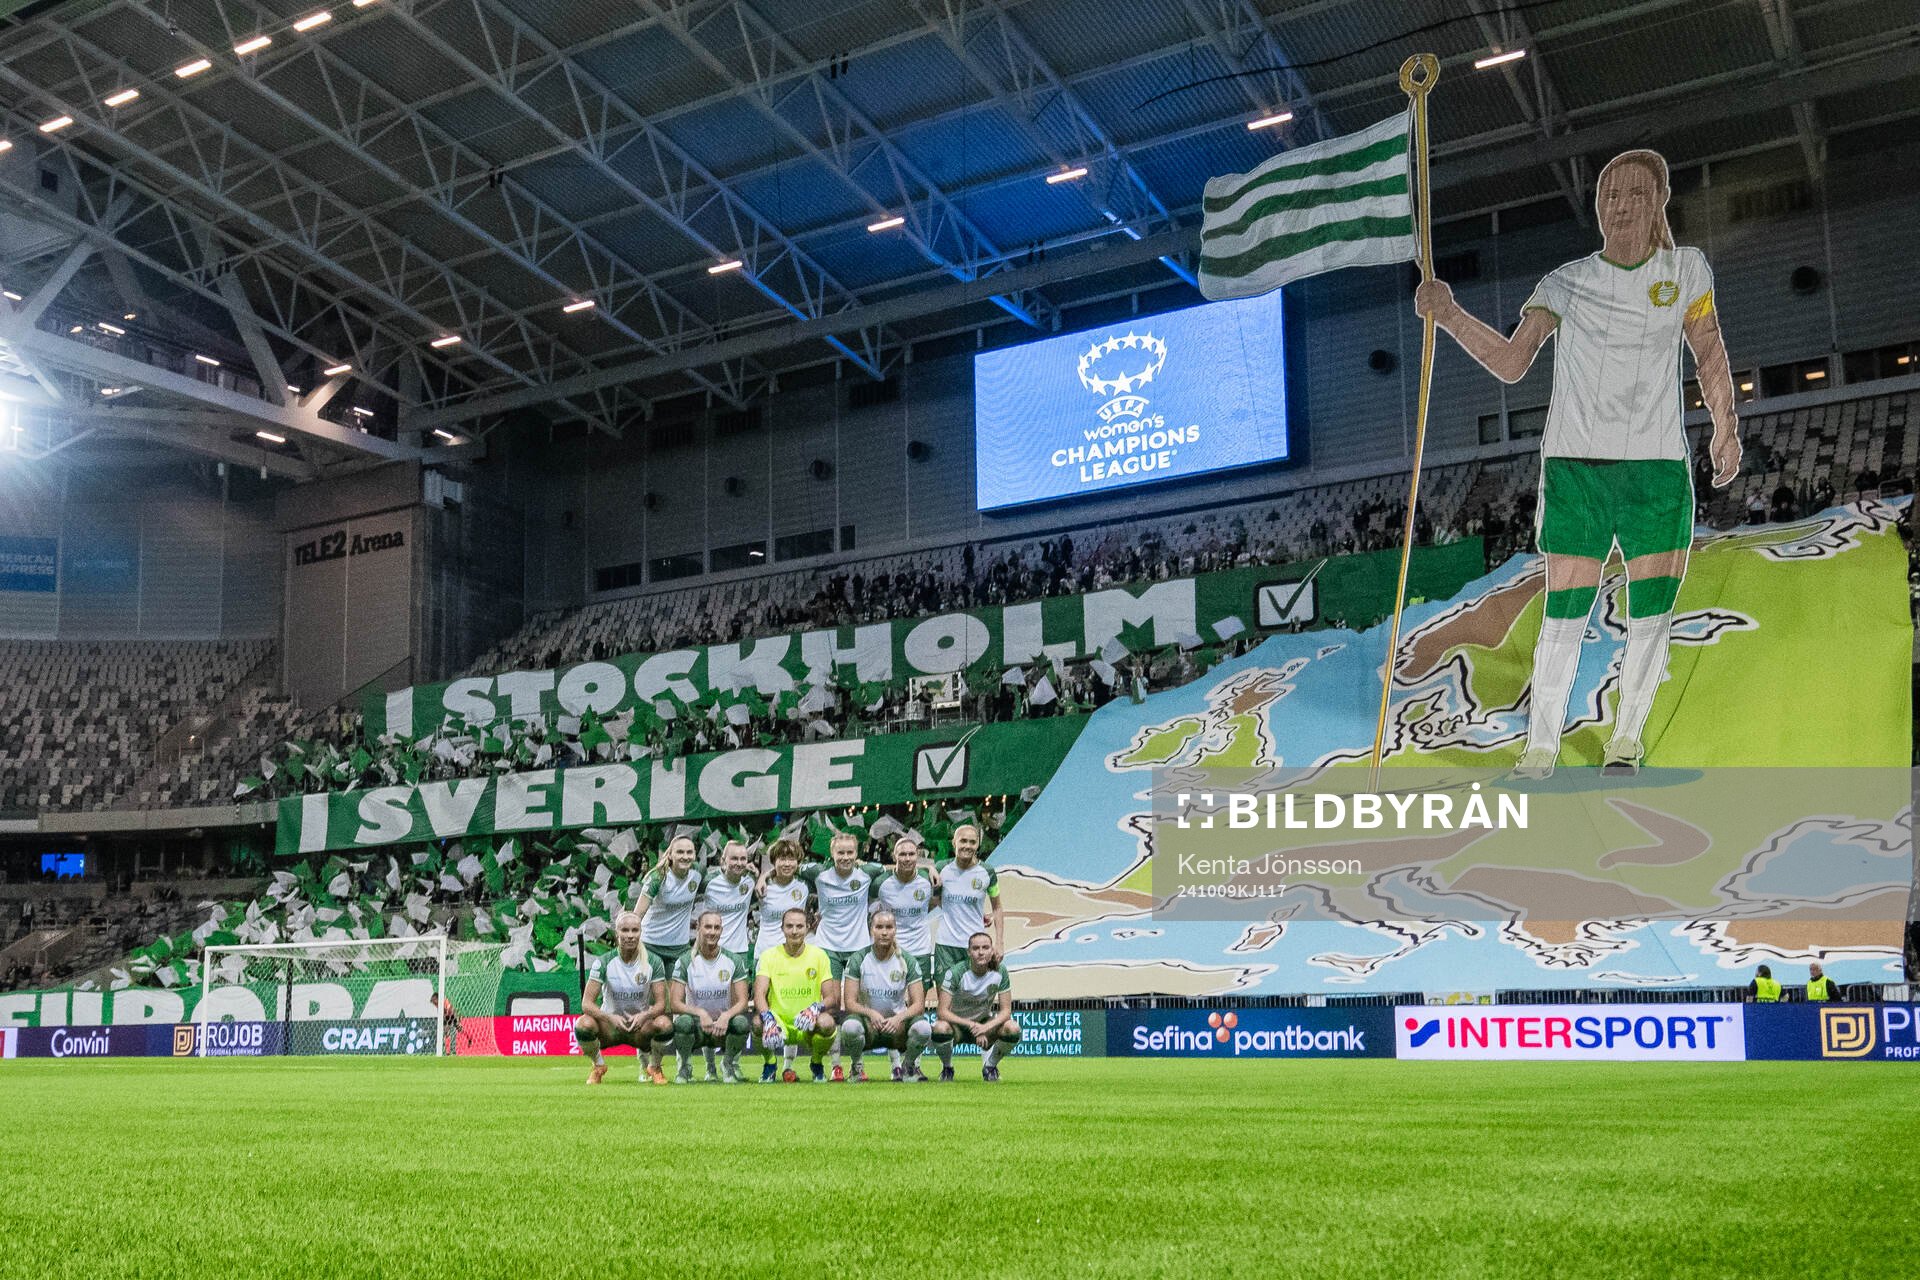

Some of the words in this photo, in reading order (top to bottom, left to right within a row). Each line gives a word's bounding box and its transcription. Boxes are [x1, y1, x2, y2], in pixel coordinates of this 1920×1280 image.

[1099, 399, 1145, 421] UEFA
[1084, 412, 1165, 441] women's
[1051, 425, 1200, 467] CHAMPIONS
[1080, 453, 1171, 483] LEAGUE
[295, 530, 347, 566] TELE2
[349, 531, 405, 556] Arena
[0, 565, 55, 575] XPRESS
[443, 578, 1197, 728] STOCKHOLM
[299, 792, 329, 853] I
[354, 739, 865, 845] SVERIGE
[51, 1028, 110, 1057] Convini
[196, 1024, 263, 1047] PROJOB
[322, 1027, 407, 1051] CRAFT
[512, 1039, 547, 1055] BANK
[1022, 1026, 1081, 1042] ERANTÖR
[1133, 1025, 1212, 1050] Sefina
[1234, 1025, 1366, 1055] pantbank
[1447, 1015, 1724, 1050] INTERSPORT
[1046, 1044, 1082, 1055] DAMER
